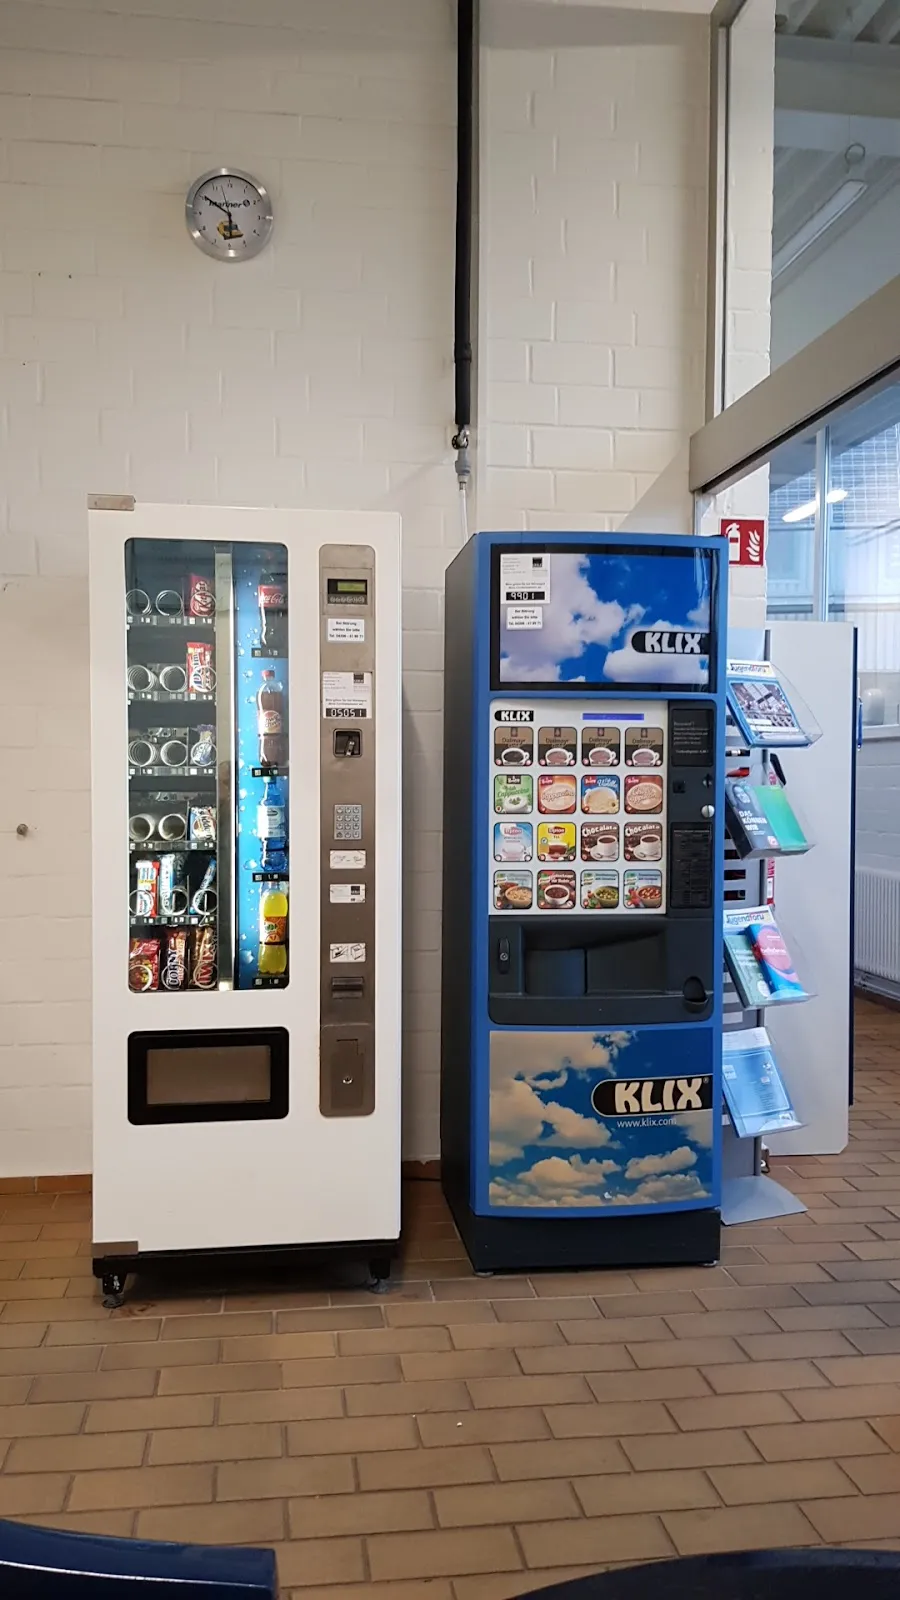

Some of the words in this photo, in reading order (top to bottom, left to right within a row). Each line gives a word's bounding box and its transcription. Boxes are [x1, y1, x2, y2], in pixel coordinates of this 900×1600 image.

[644, 631, 701, 653] KLIX
[500, 710, 531, 722] KLIX
[614, 1078, 703, 1113] KLIX
[617, 1117, 677, 1128] www.klix.com
